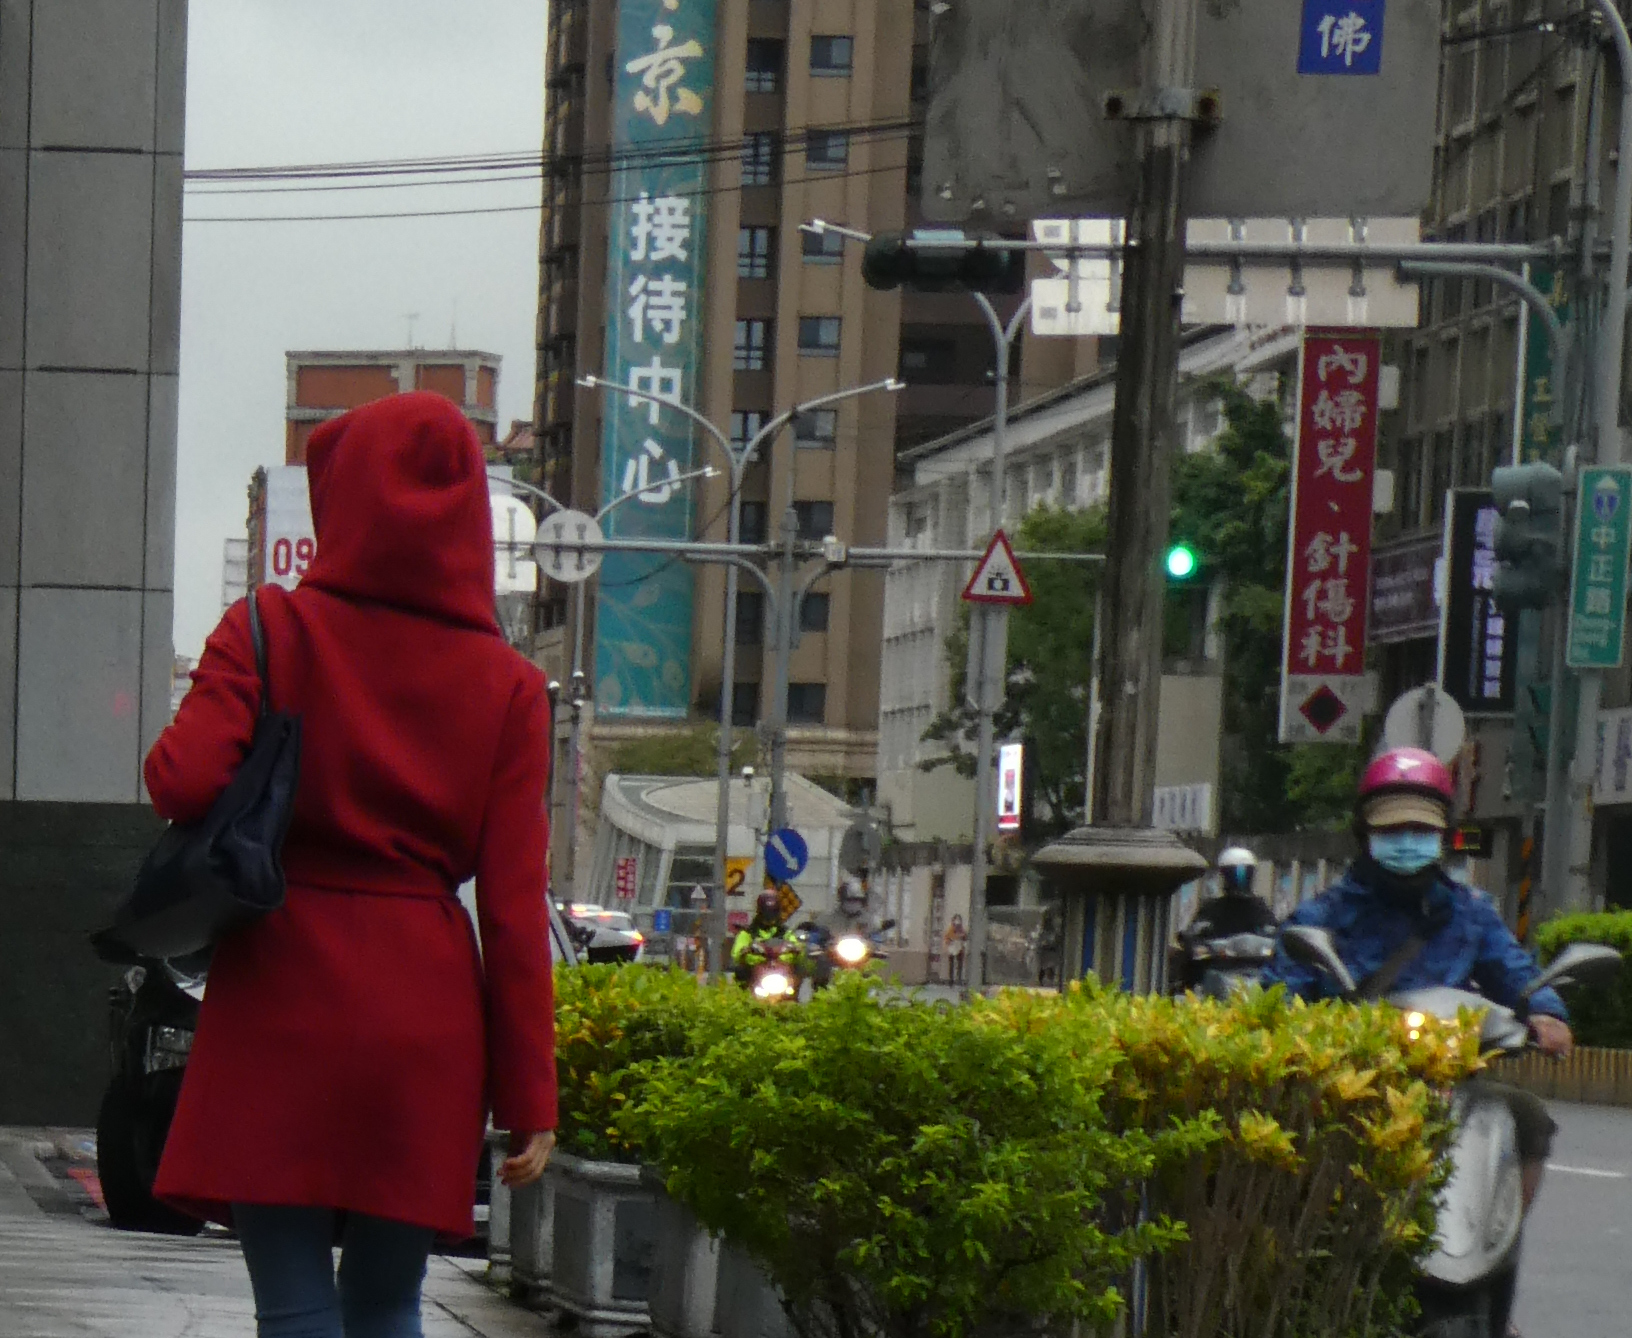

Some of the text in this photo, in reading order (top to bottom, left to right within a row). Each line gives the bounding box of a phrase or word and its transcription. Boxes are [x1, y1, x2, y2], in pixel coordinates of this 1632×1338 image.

[625, 25, 705, 125] 京
[1316, 11, 1372, 67] 佛
[621, 192, 691, 505] 接待中心
